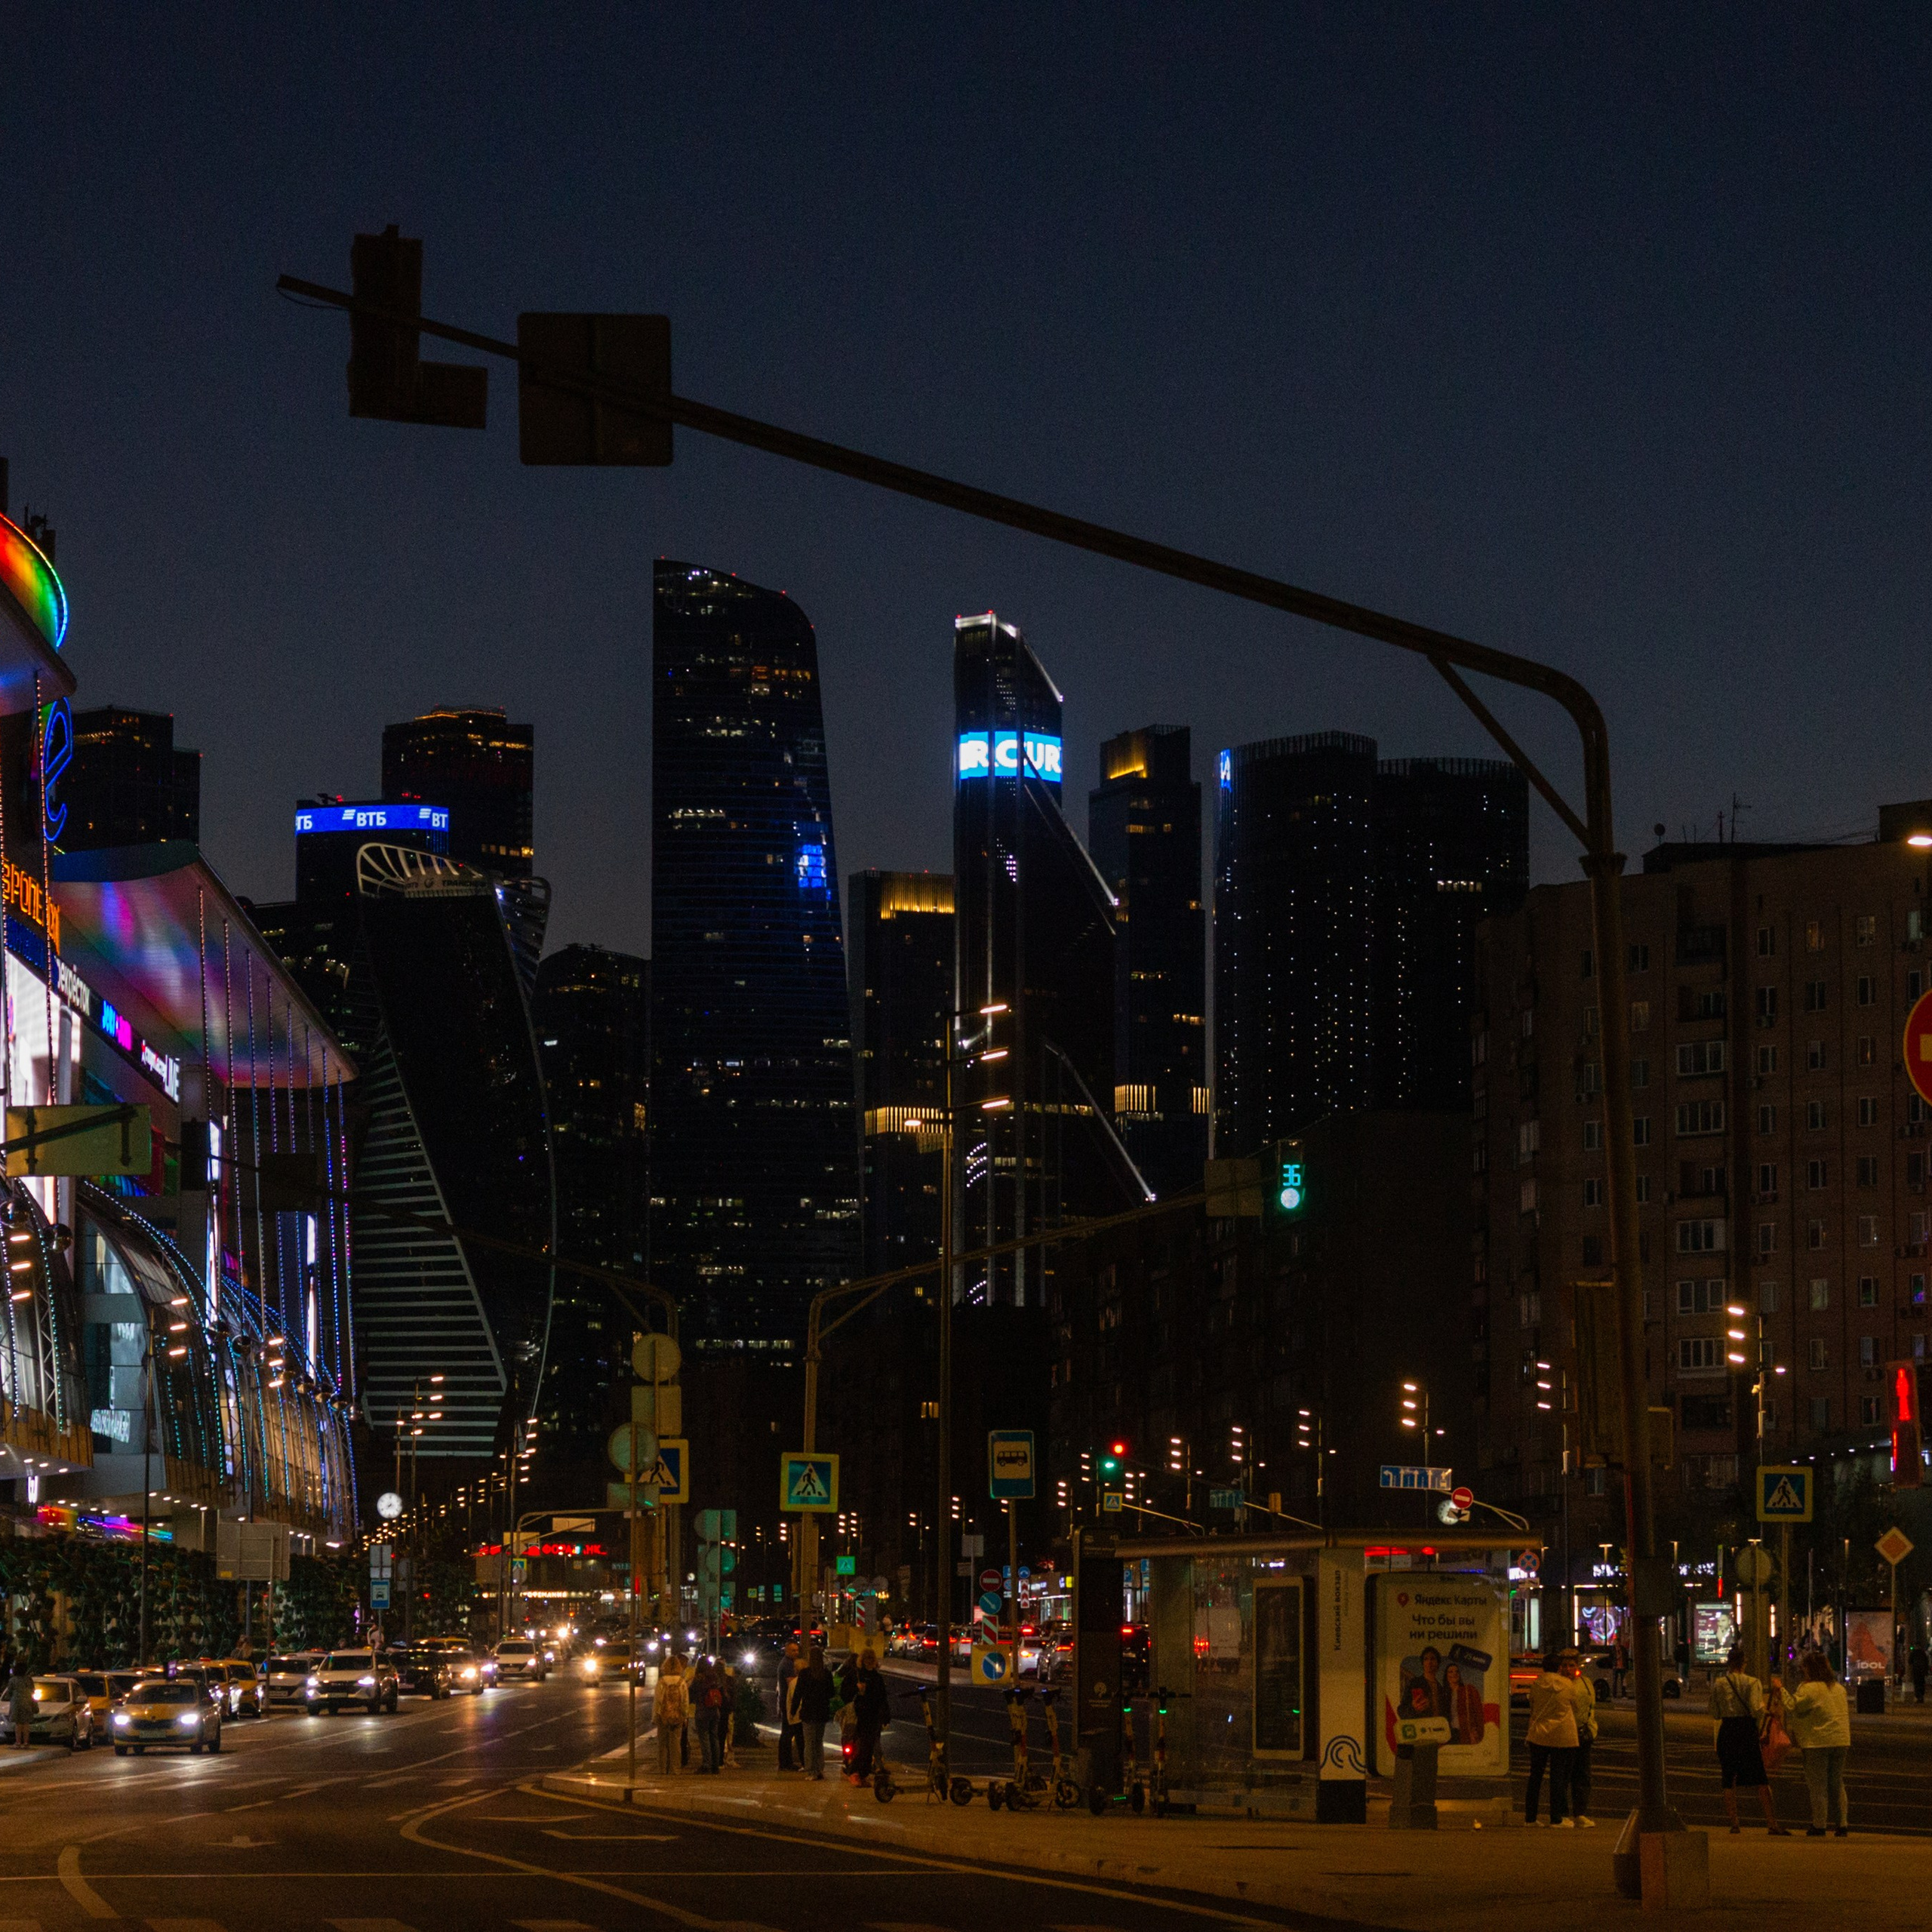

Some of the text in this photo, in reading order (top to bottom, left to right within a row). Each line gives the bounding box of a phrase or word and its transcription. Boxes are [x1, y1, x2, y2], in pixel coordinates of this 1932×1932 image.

[295, 814, 313, 831] ТБ
[356, 811, 386, 827] ВТБ
[1282, 1164, 1301, 1186] 36
[1414, 1594, 1487, 1607] Яндекс Карты
[1412, 1614, 1475, 1626] Что бы вы
[1409, 1629, 1478, 1641] ни решили
